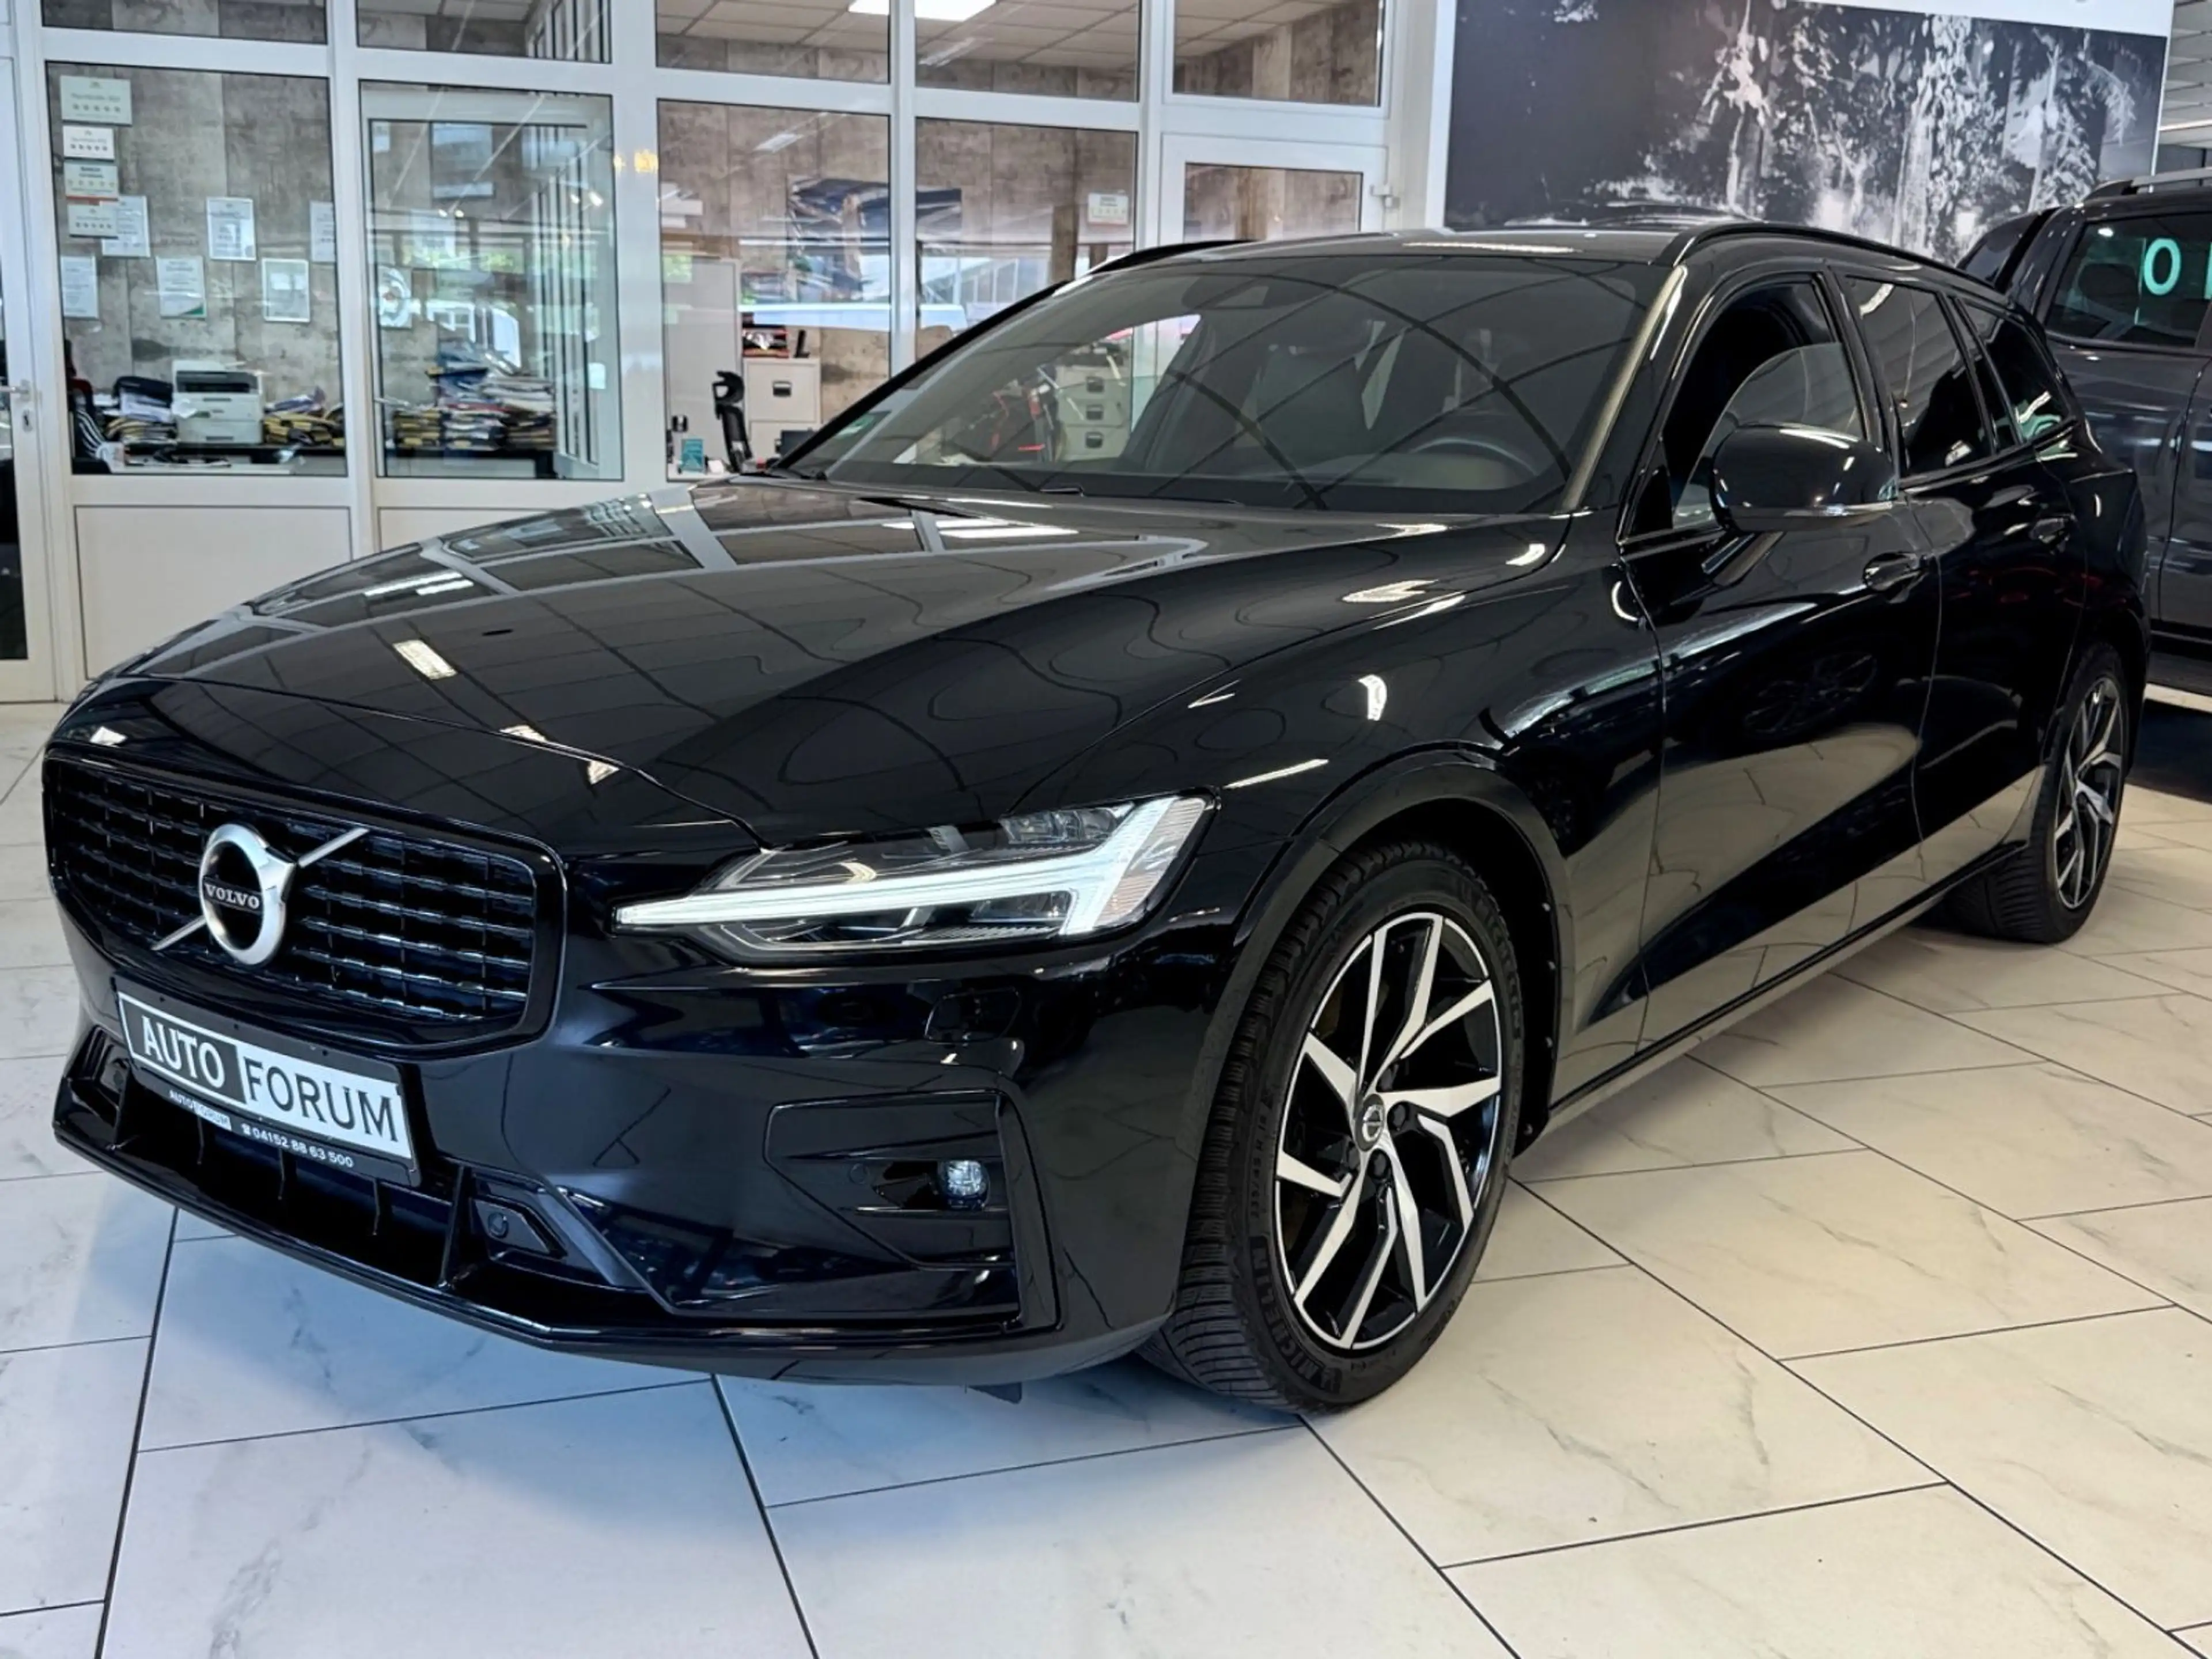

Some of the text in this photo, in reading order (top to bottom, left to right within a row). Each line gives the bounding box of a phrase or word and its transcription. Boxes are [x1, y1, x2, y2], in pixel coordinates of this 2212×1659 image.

[204, 882, 260, 909] VOLVO
[141, 1015, 399, 1142] AUTO FORUM
[252, 1127, 289, 1148] 04152
[328, 1150, 355, 1168] 500
[1251, 1247, 1320, 1381] MICHELIN
